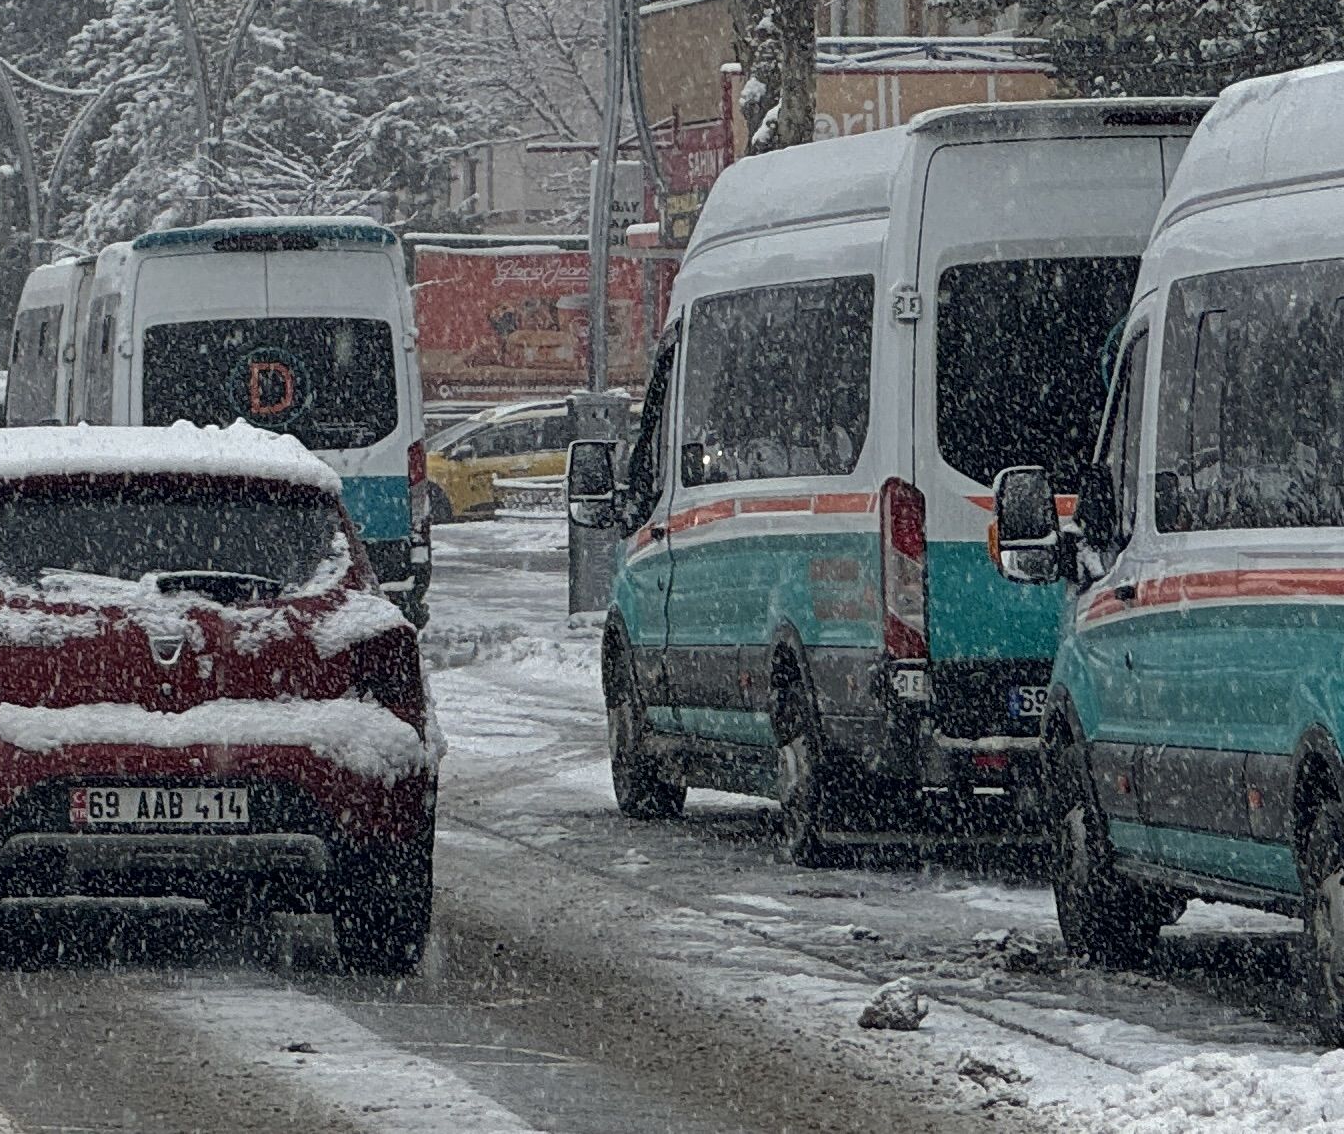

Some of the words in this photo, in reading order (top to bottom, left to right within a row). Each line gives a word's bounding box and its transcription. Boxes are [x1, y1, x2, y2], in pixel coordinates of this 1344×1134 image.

[89, 791, 120, 819] 69
[137, 791, 184, 819] AAB
[195, 791, 243, 819] 414
